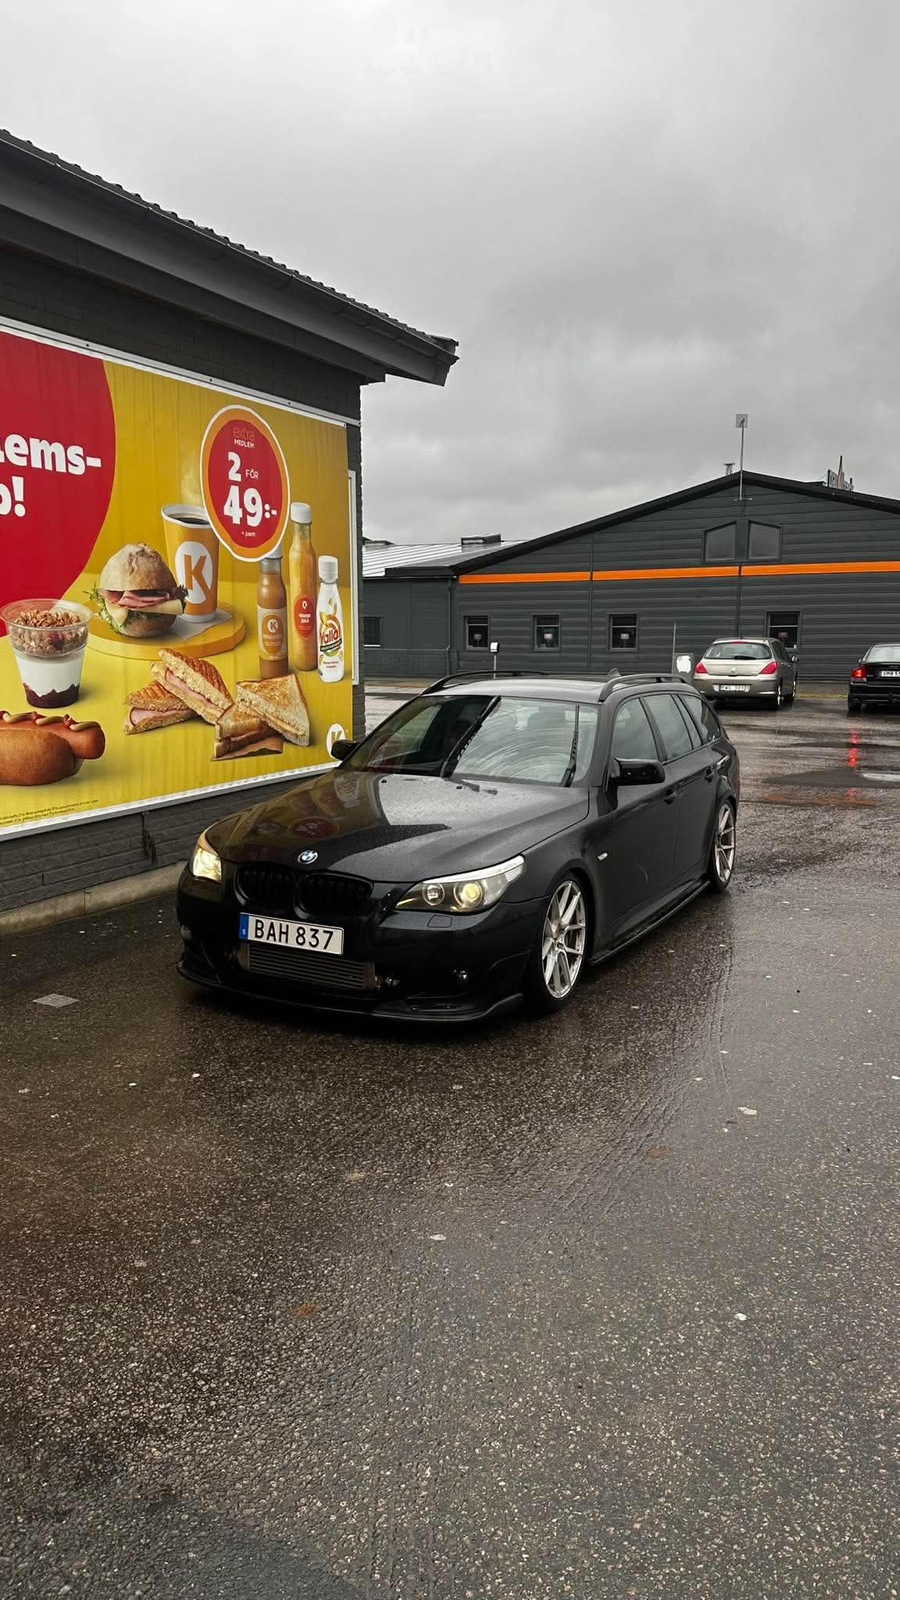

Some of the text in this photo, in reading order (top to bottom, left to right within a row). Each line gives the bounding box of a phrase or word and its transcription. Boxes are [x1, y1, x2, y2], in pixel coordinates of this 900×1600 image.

[234, 438, 255, 449] MEDLEM
[227, 451, 259, 482] 2 FÖR
[223, 485, 278, 528] 49:-
[184, 553, 210, 597] K
[254, 919, 334, 951] BAH 837
